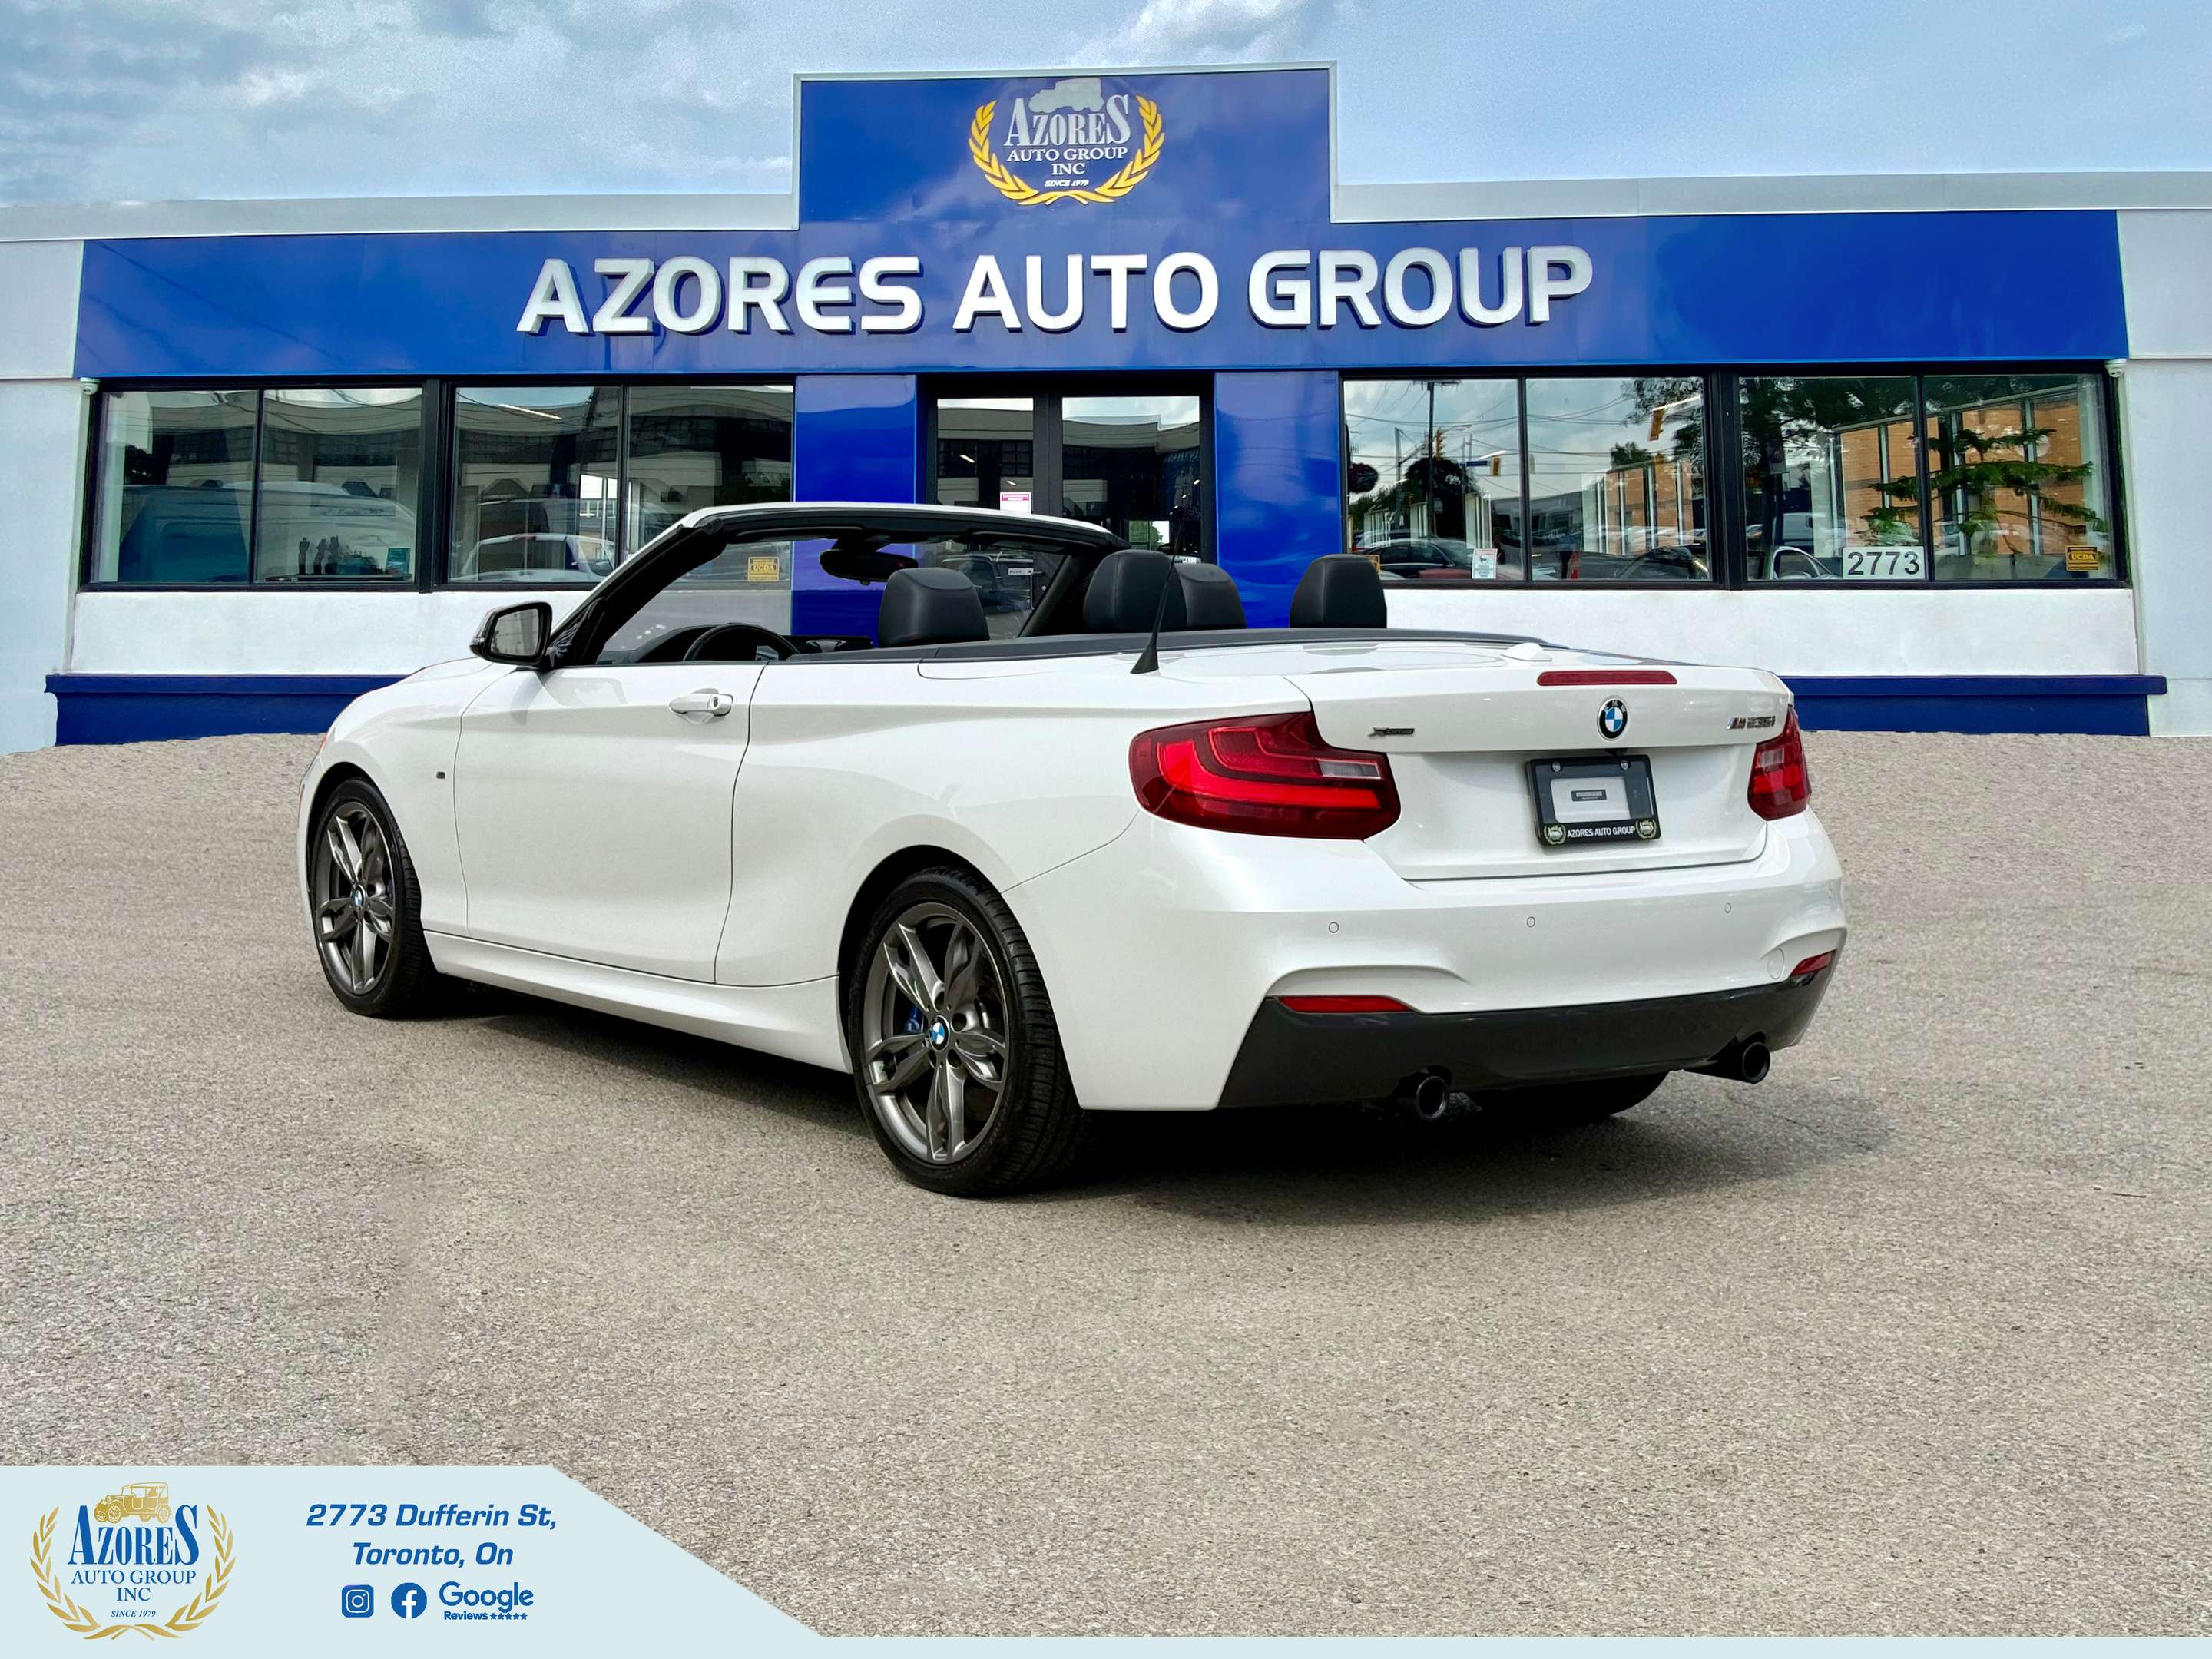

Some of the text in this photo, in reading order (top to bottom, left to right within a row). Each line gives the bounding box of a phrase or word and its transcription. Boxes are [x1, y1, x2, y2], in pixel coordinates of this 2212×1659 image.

[1004, 94, 1131, 147] AZORES
[1006, 147, 1128, 161] AUTO GROUP
[1051, 163, 1086, 175] INC
[517, 245, 1593, 335] AZORES AUTO GROUP
[1847, 551, 1920, 575] 2773
[1567, 830, 1594, 838] AZORES
[1594, 828, 1612, 836] AUTO
[1613, 826, 1635, 835] GROUP
